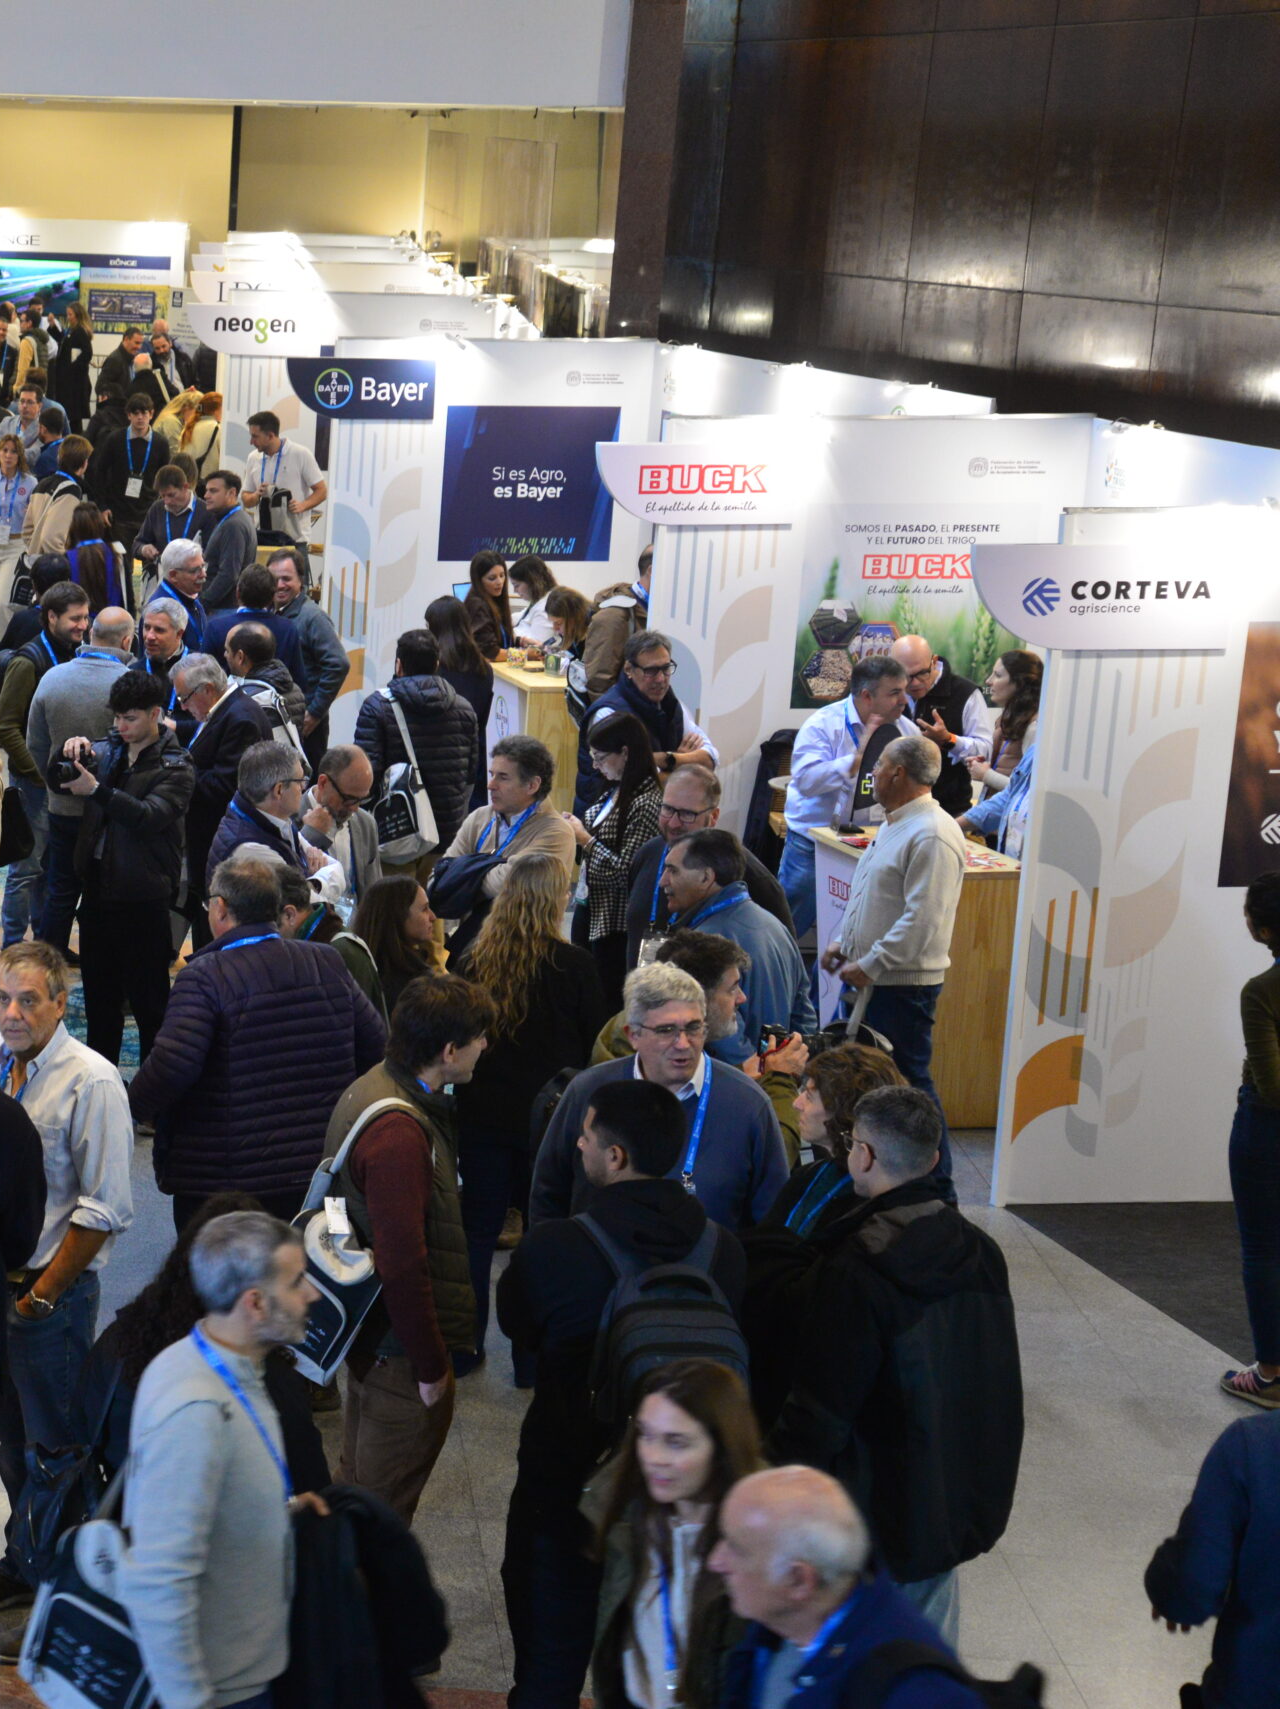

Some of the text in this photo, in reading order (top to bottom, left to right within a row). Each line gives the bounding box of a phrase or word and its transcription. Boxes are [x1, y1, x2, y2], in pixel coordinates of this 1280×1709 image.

[214, 316, 296, 344] neogen
[317, 384, 350, 393] BAYER
[360, 376, 429, 407] Bayer
[492, 466, 567, 485] Si es Agro,
[638, 464, 768, 495] BUCK
[493, 483, 564, 502] es Bayer
[645, 501, 758, 515] El apellido de la semilla
[845, 524, 1000, 534] SOMOS EL PASADO, EL PRESENTE
[866, 536, 977, 545] Y EL FUTURO DEL TRIGO
[862, 554, 974, 580] BUCK
[867, 585, 964, 597] El apellido de la semilla
[1070, 580, 1212, 600] CORTEVA
[1069, 603, 1142, 616] agriscience
